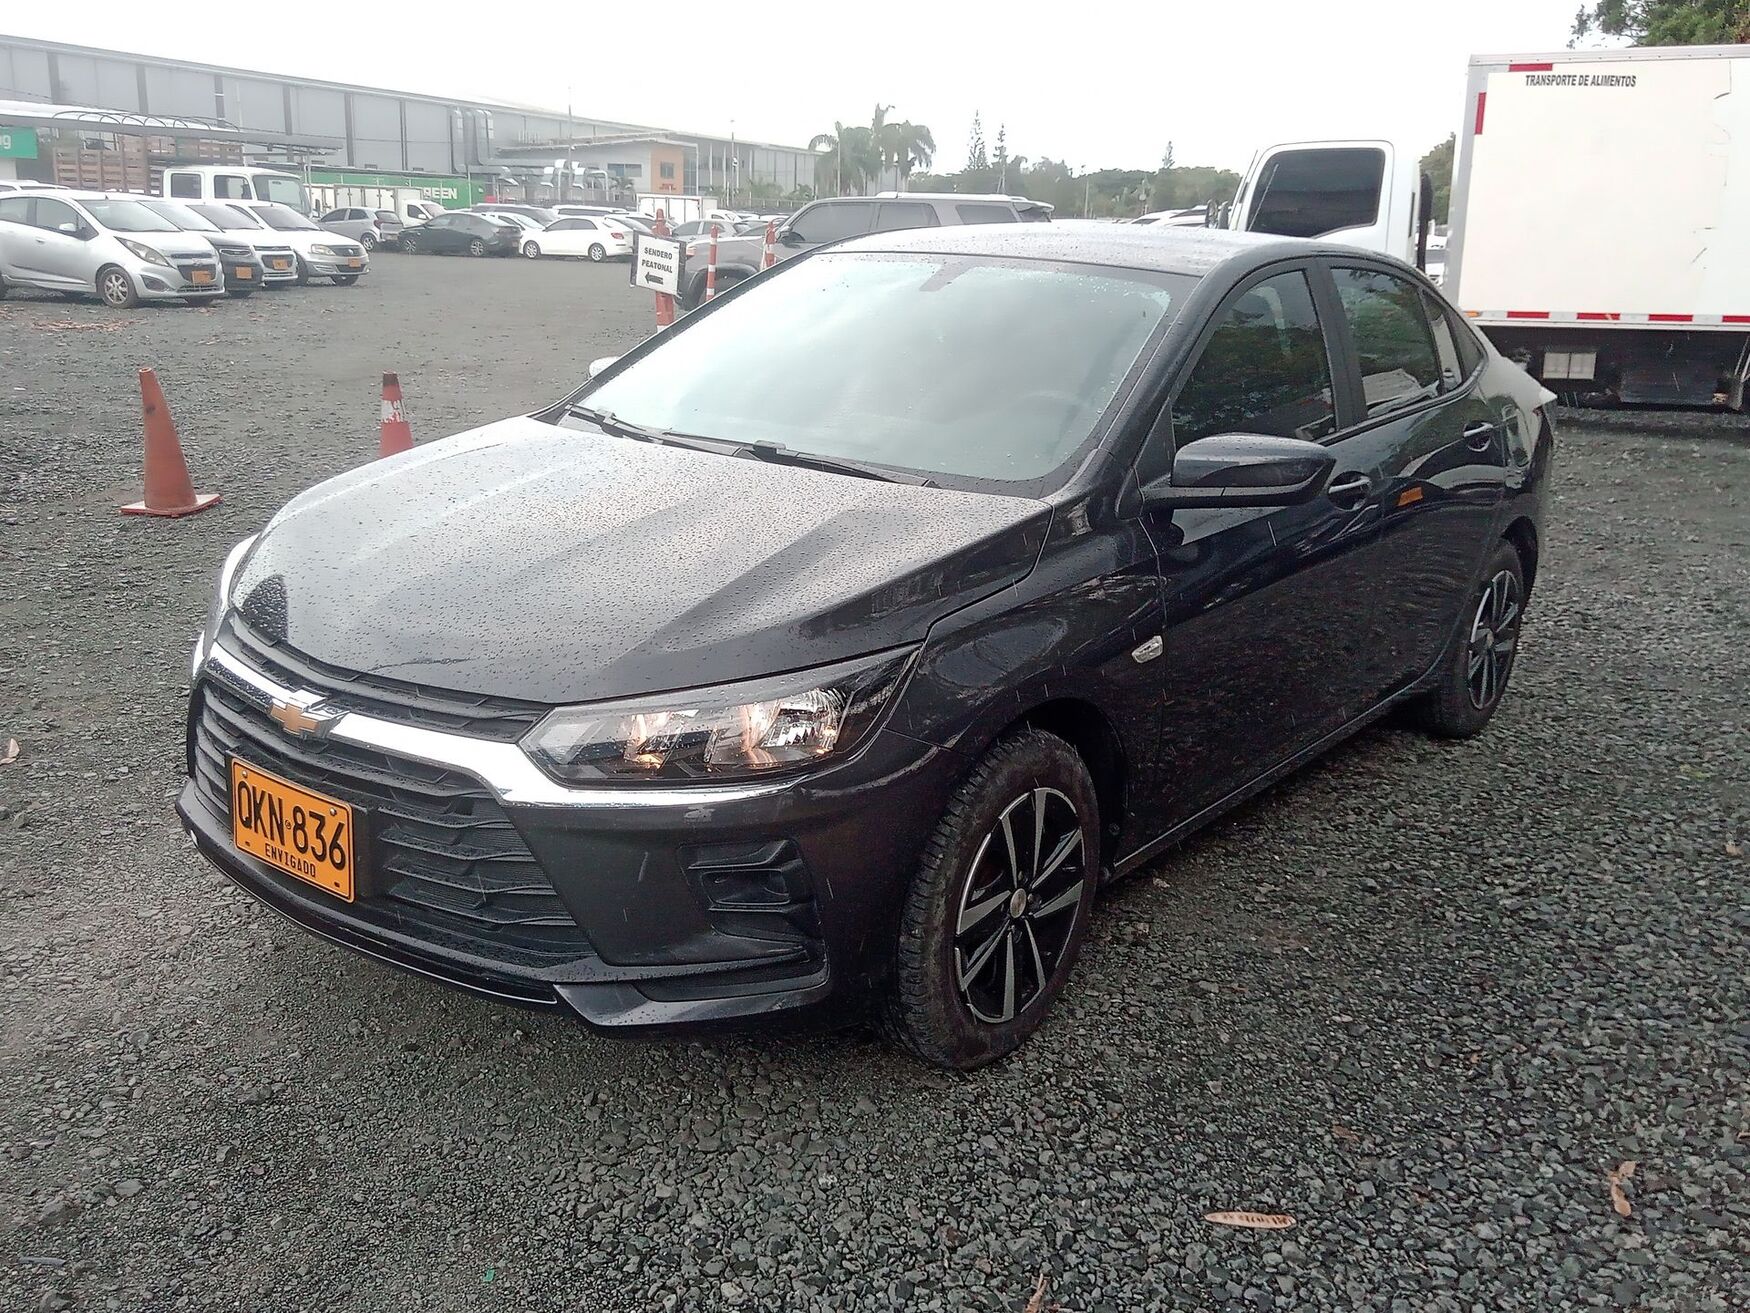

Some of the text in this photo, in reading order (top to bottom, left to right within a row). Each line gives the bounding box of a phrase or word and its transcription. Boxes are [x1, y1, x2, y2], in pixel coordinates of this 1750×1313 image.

[1525, 74, 1637, 88] TRANSPORTE DE ALIMENTOS
[423, 186, 458, 200] REEN
[644, 246, 673, 260] SENDERO
[641, 258, 673, 274] PEATONAL
[264, 842, 316, 878] ENVIGADO
